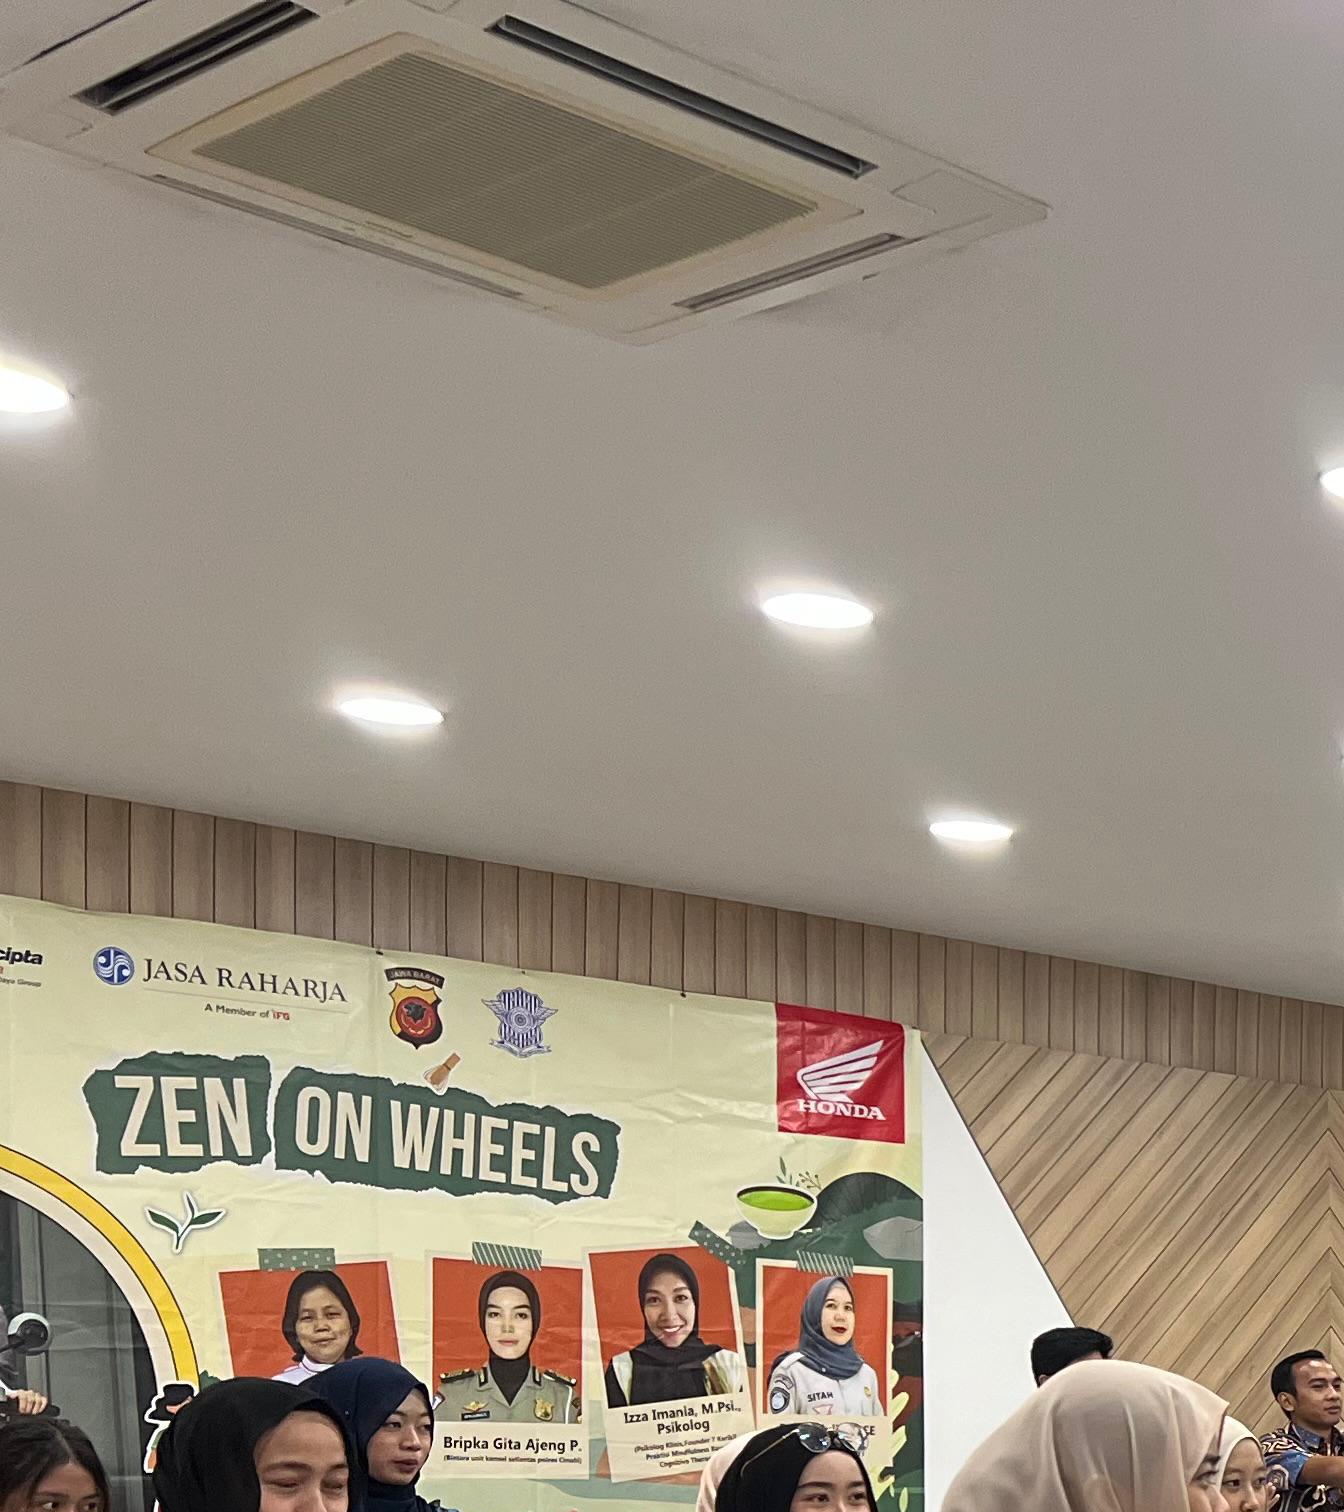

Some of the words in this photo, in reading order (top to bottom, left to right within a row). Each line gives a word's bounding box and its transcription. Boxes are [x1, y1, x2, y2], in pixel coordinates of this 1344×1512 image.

[143, 958, 208, 985] JASA
[216, 967, 348, 1003] RAHARJA
[413, 971, 440, 984] BARAT
[204, 1003, 213, 1012] A
[215, 1005, 257, 1018] Member
[259, 1010, 270, 1019] of
[797, 1099, 886, 1120] HONDA
[113, 1075, 253, 1158] ZEN
[294, 1086, 372, 1163] ON
[388, 1100, 600, 1197] WHEELS
[623, 1412, 649, 1424] Izza
[651, 1406, 698, 1421] Imania,
[657, 1420, 710, 1435] Psikolog
[443, 1436, 489, 1453] Bripka
[493, 1437, 521, 1451] Gita
[525, 1438, 566, 1455] Ajeng
[570, 1440, 582, 1452] P.
